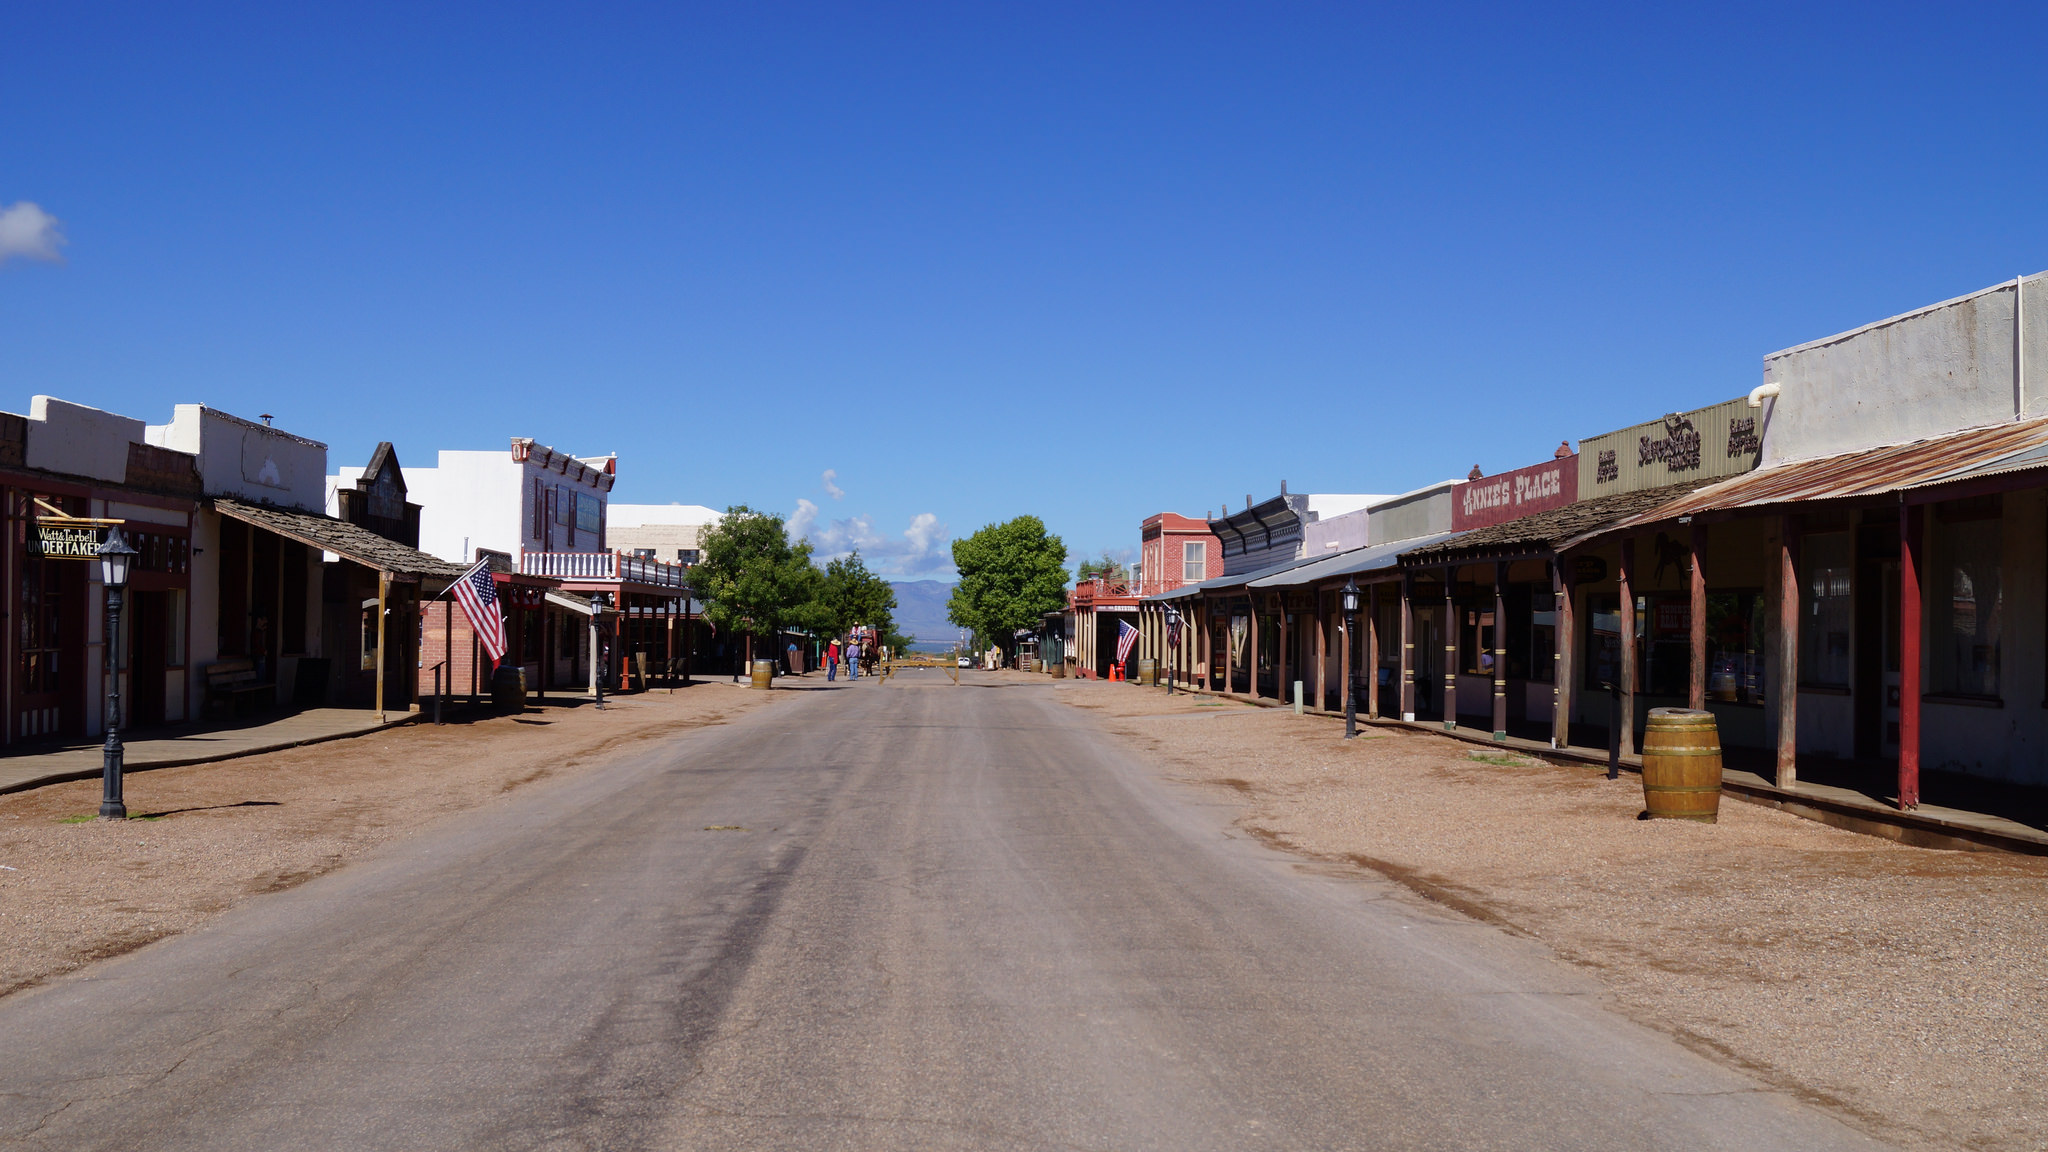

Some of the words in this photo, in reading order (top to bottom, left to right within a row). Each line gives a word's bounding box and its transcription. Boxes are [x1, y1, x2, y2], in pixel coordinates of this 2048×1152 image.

[1463, 478, 1510, 516] ANNIE'S
[1514, 469, 1560, 505] PLACE
[27, 539, 104, 556] UNDERTAKER
